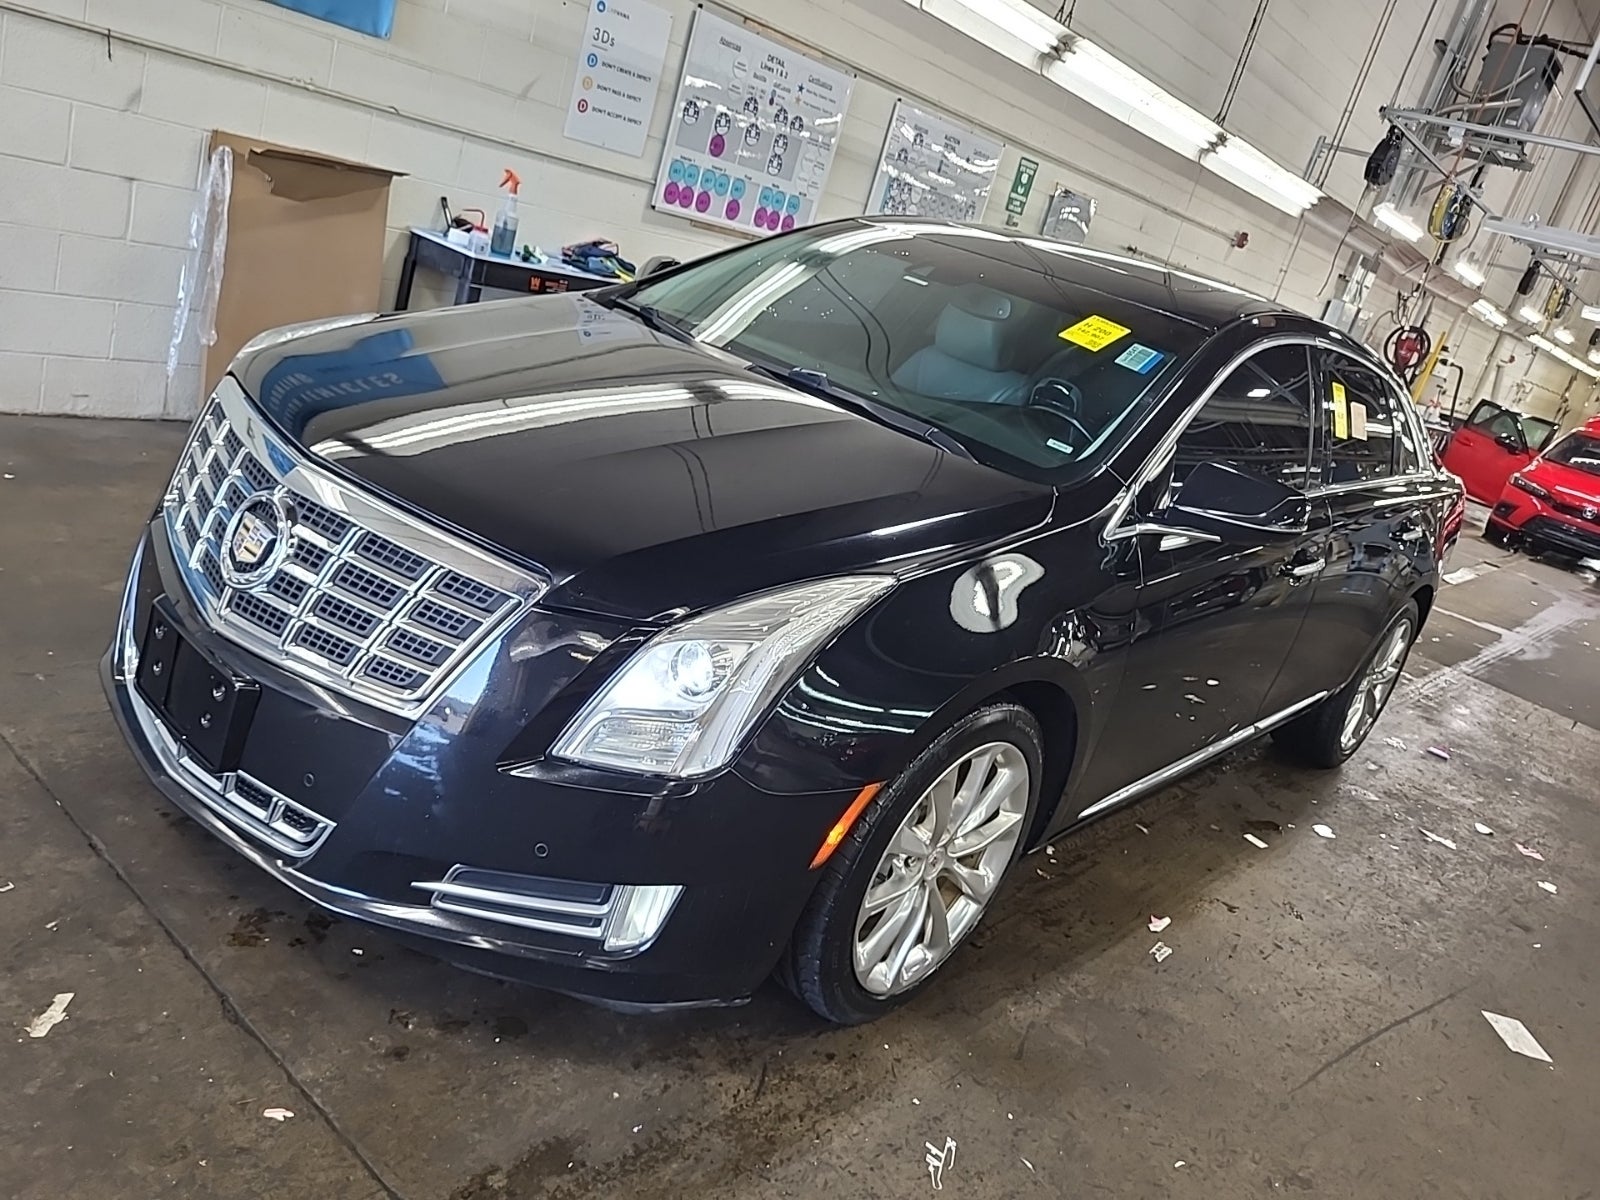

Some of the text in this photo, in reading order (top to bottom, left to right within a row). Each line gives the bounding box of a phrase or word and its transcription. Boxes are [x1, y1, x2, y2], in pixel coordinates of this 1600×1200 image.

[592, 27, 616, 47] 3Ds
[601, 60, 616, 71] DON'T
[767, 54, 785, 68] DETAIL
[760, 62, 775, 74] Lines
[596, 84, 611, 93] DON'T
[591, 106, 607, 116] DON'T
